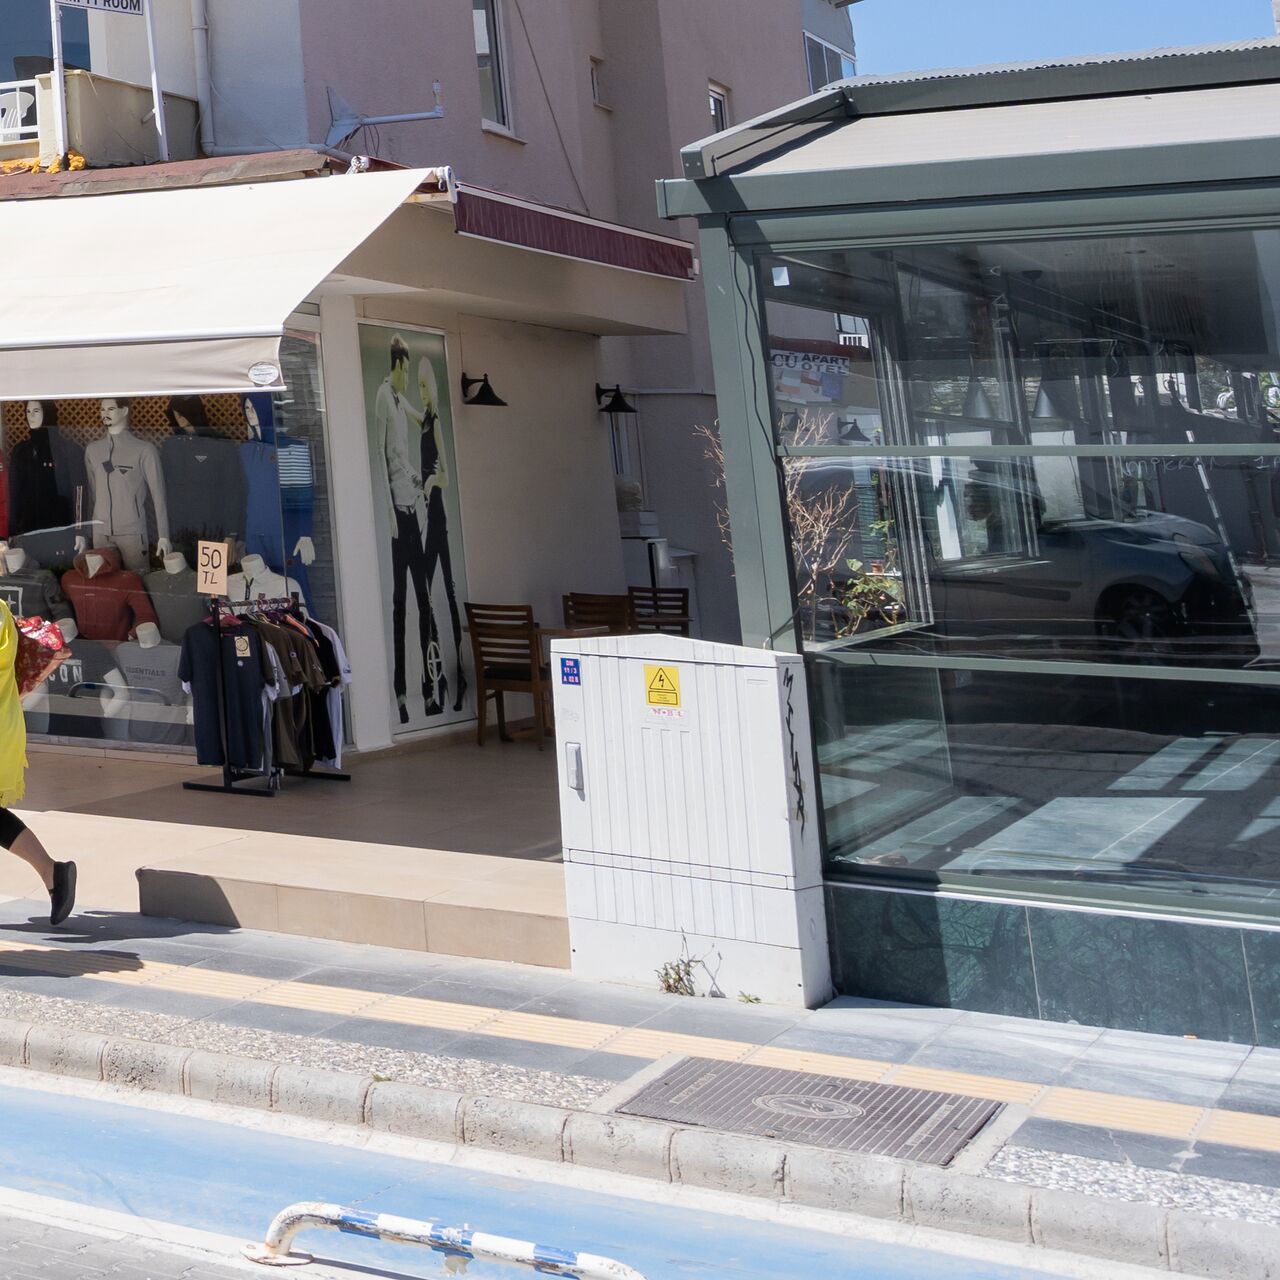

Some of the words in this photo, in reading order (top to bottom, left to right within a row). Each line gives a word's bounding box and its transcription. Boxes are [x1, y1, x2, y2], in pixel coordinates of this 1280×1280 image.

[801, 353, 849, 365] APART
[201, 546, 222, 569] 50
[202, 570, 218, 585] TL
